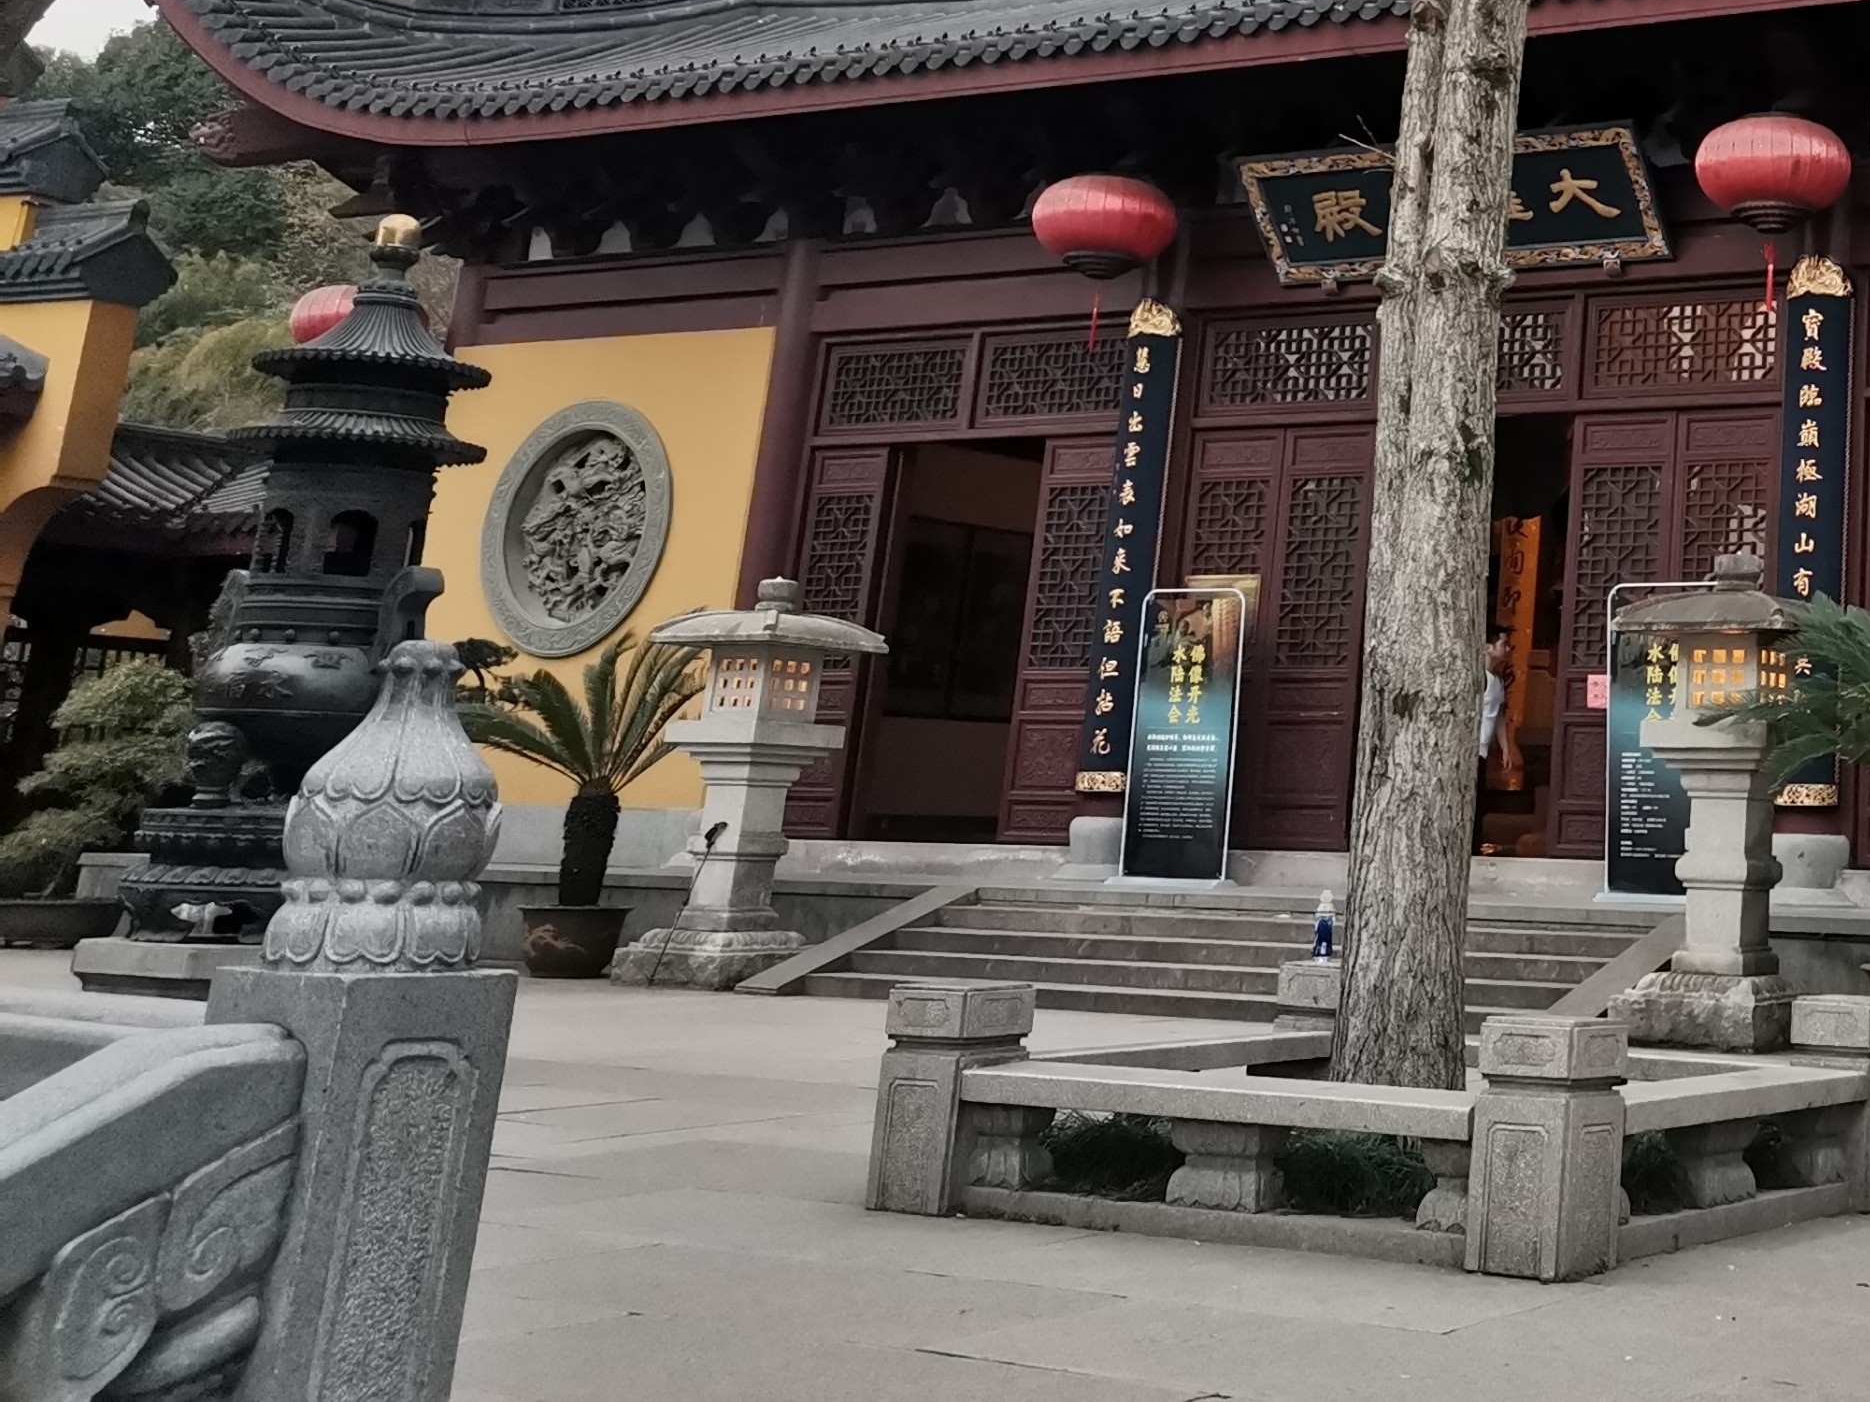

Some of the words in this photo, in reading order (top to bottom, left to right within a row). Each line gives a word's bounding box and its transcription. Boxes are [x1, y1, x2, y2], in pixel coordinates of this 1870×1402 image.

[1311, 167, 1622, 243] 大殿
[1168, 643, 1187, 724] 水陆法会
